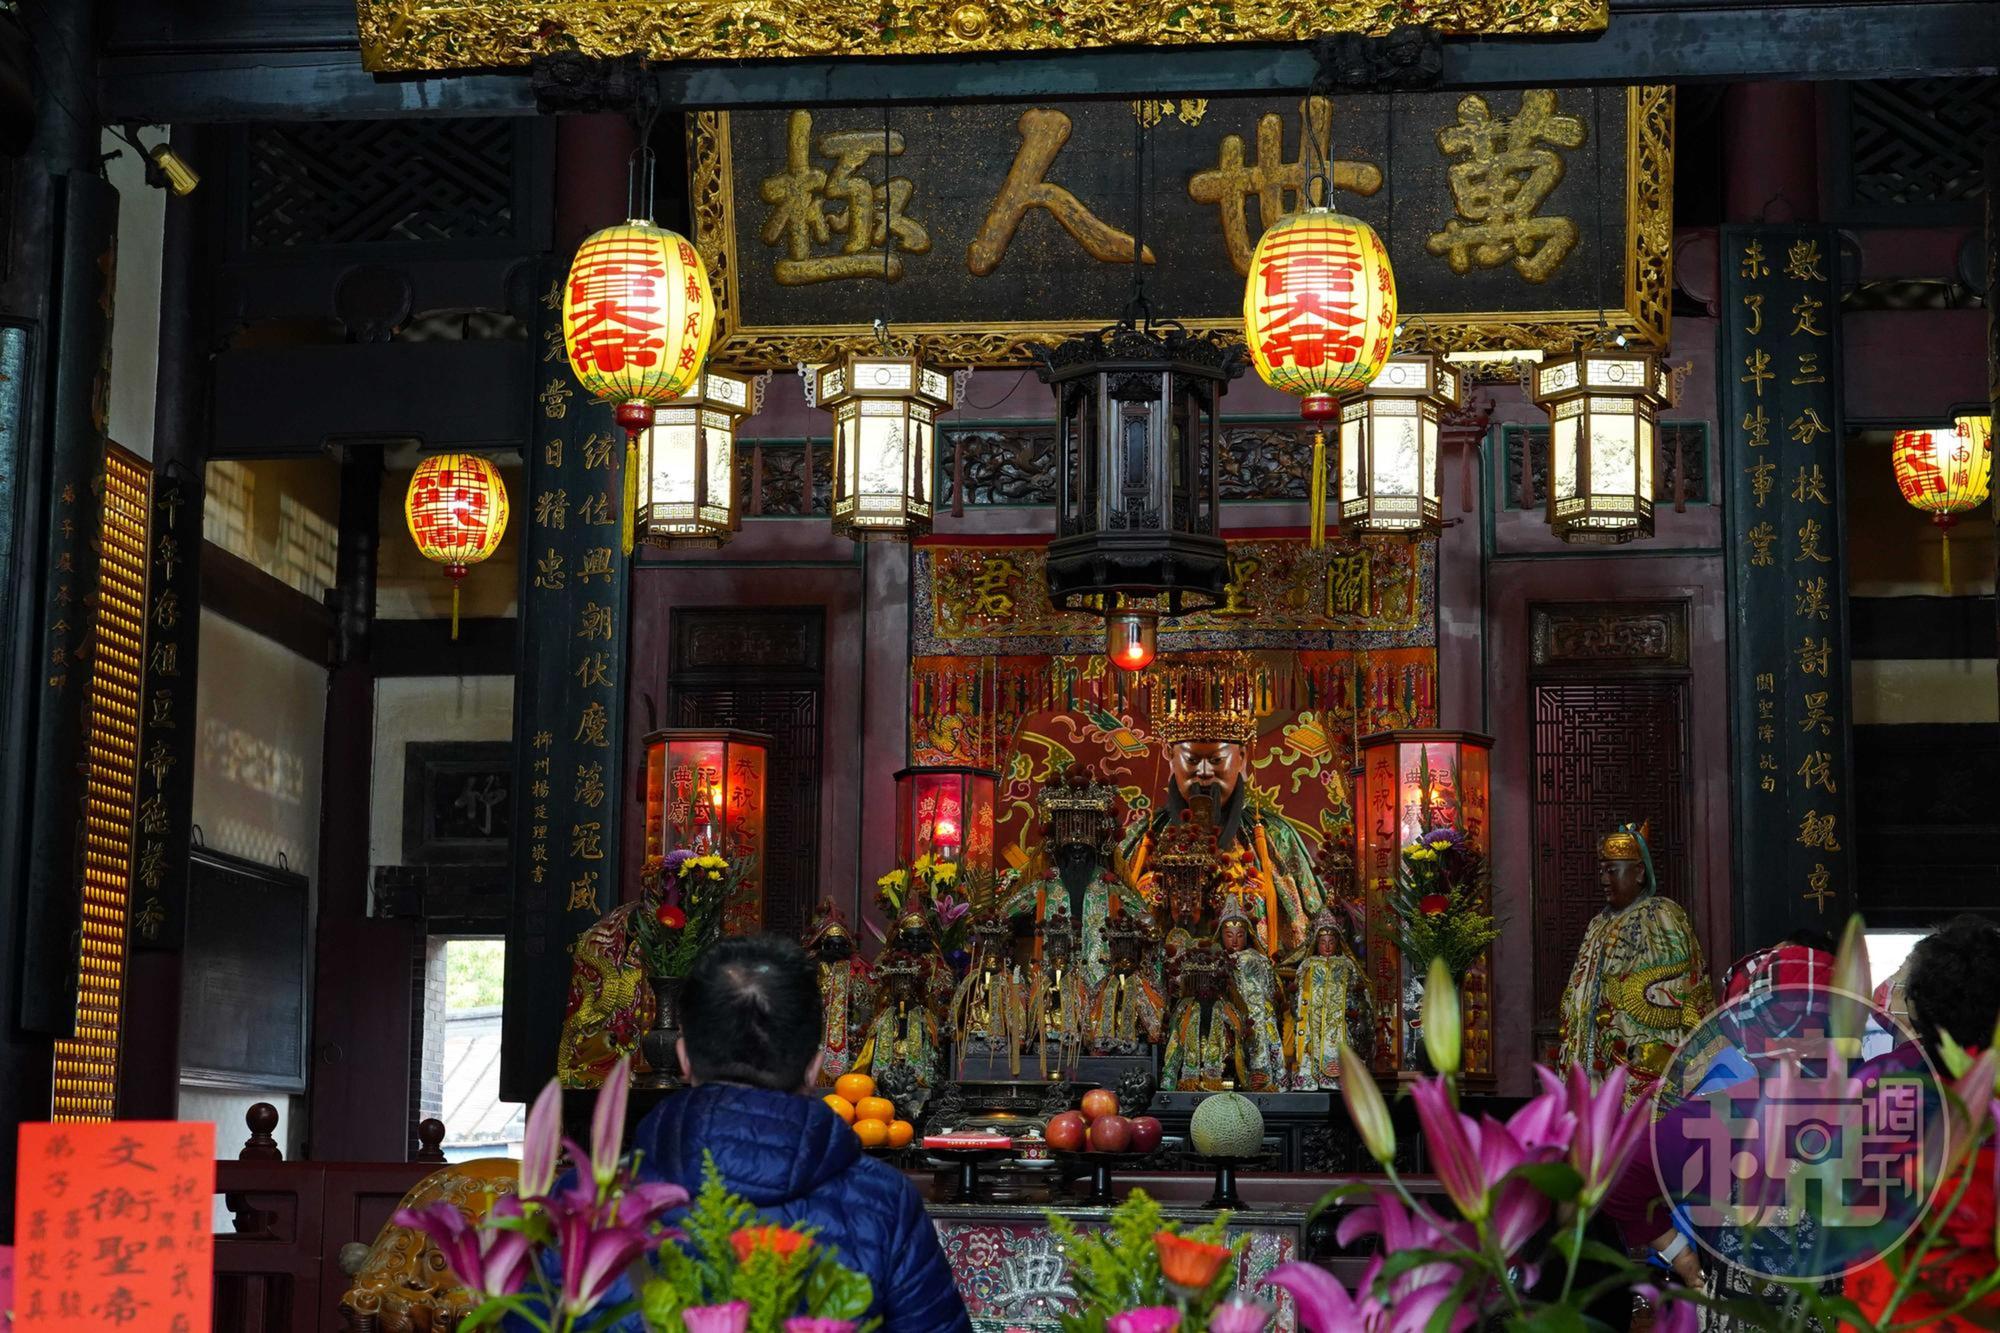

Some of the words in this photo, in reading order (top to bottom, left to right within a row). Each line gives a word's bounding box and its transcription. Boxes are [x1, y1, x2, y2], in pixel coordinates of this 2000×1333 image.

[759, 88, 1588, 286] 萬世人極
[562, 237, 666, 373] 三官大帝
[678, 241, 704, 371] 國泰民安
[1258, 227, 1367, 369] 三官大帝
[1740, 239, 1777, 568] 未了半生事業
[86, 1134, 158, 1328] 文衡聖帝
